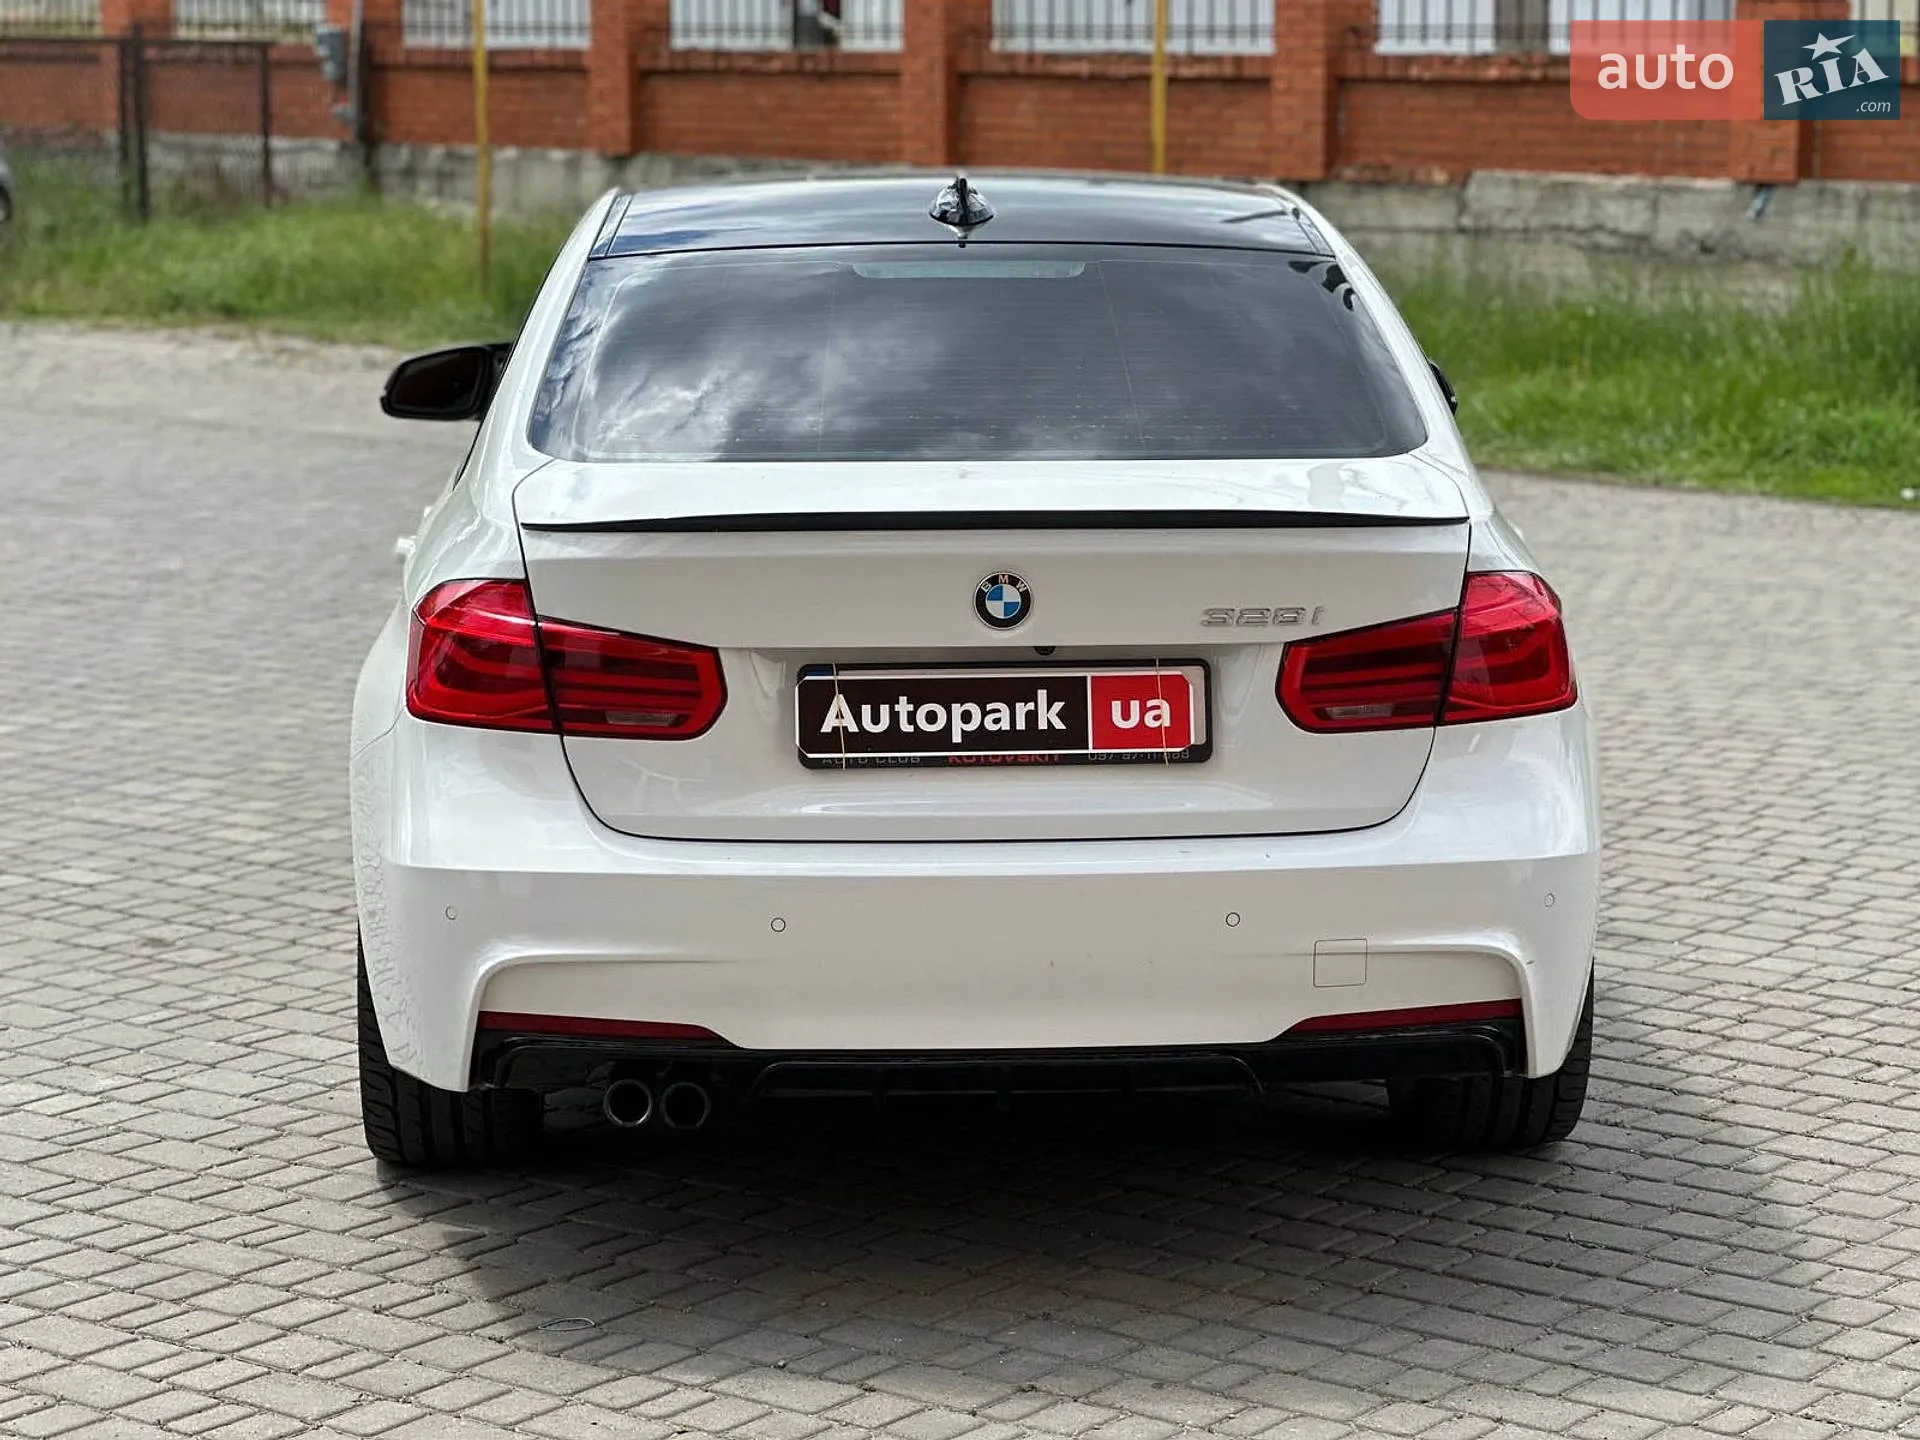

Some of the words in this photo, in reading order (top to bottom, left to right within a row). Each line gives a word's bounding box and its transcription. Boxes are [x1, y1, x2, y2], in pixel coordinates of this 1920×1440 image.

[981, 574, 1027, 592] BMW
[1200, 606, 1324, 627] 328i
[820, 689, 1067, 743] Autopark
[1111, 699, 1171, 729] ua
